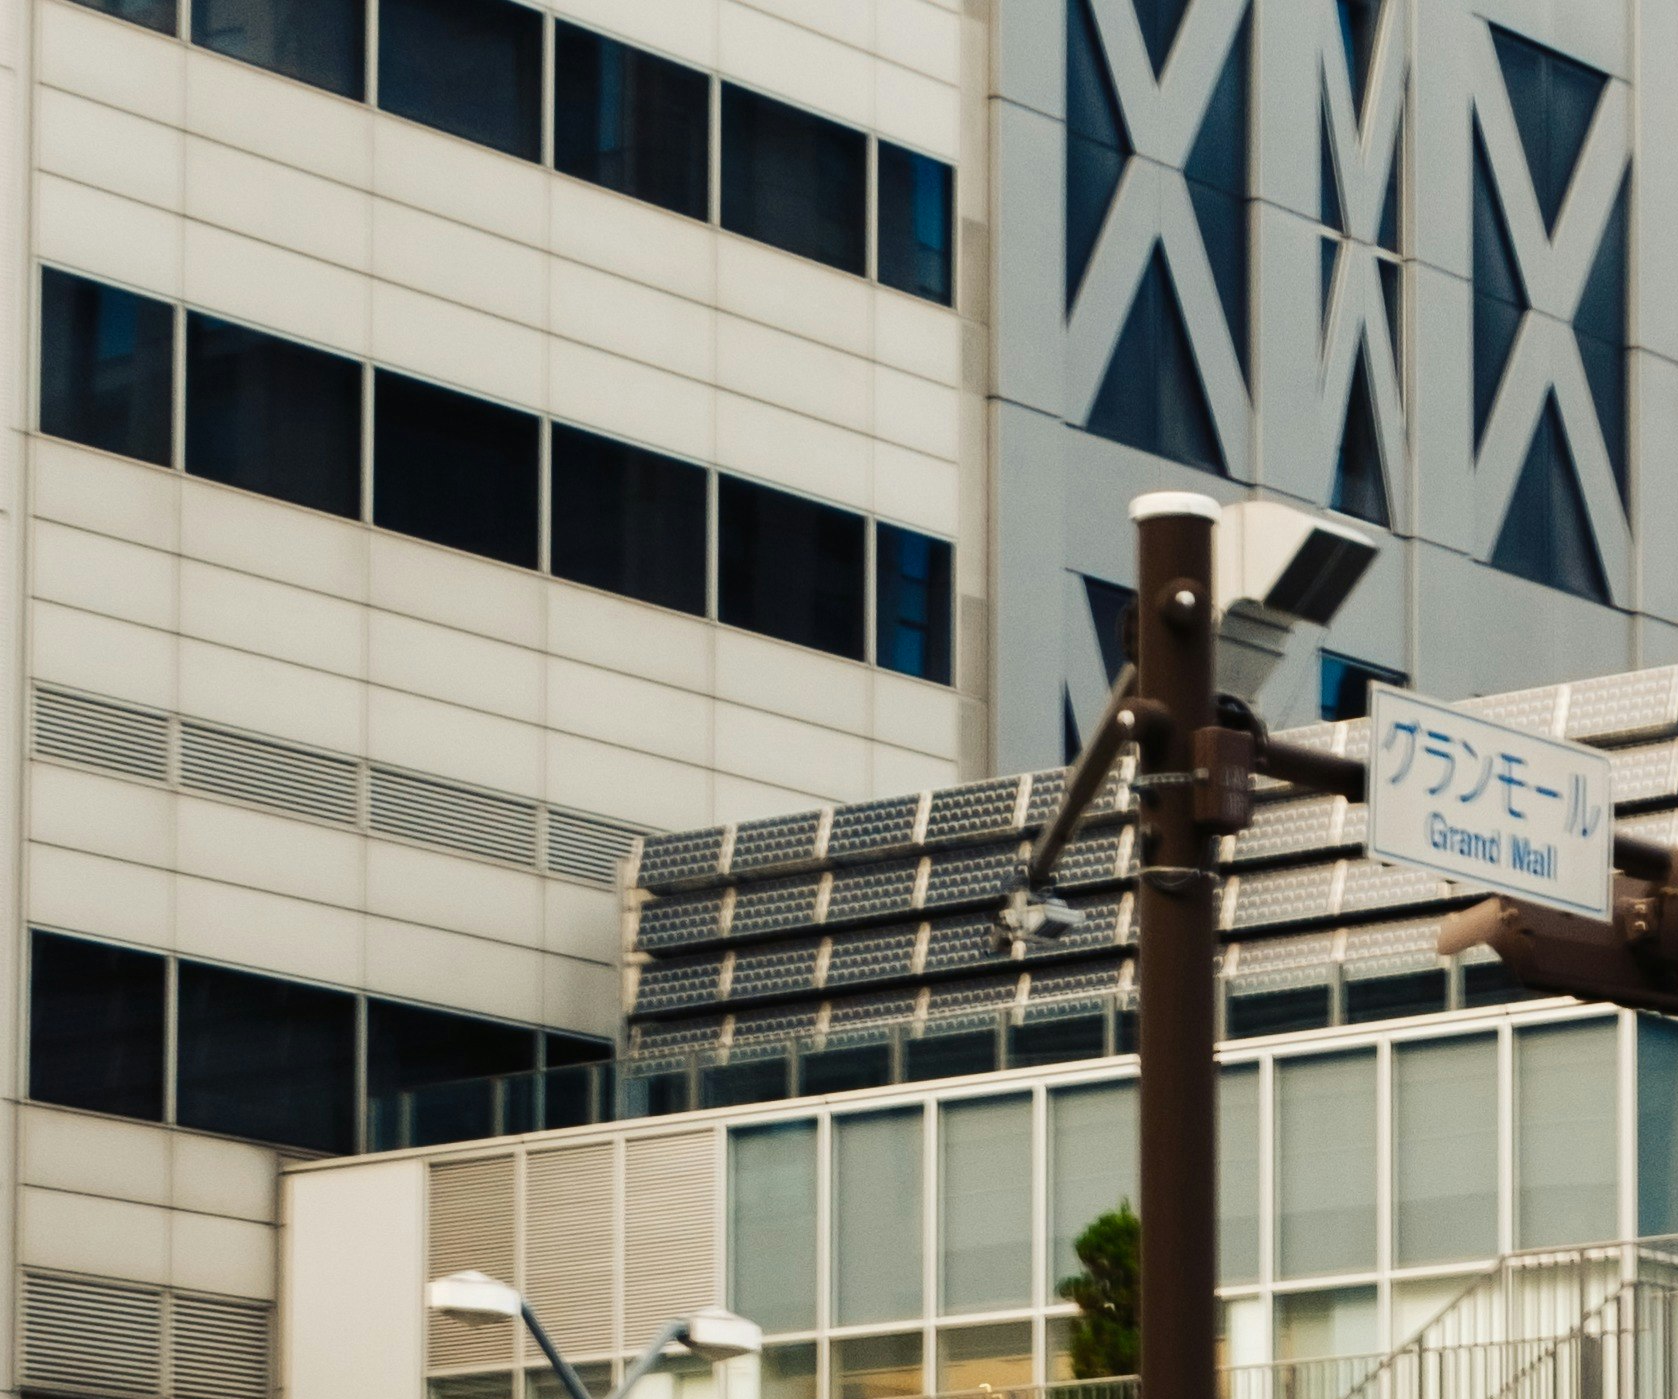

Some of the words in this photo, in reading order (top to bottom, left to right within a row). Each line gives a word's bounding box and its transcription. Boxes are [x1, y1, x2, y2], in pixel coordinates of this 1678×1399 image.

[1383, 721, 1600, 837] グランモール
[1427, 812, 1500, 864] Grand
[1511, 834, 1557, 880] Mall
